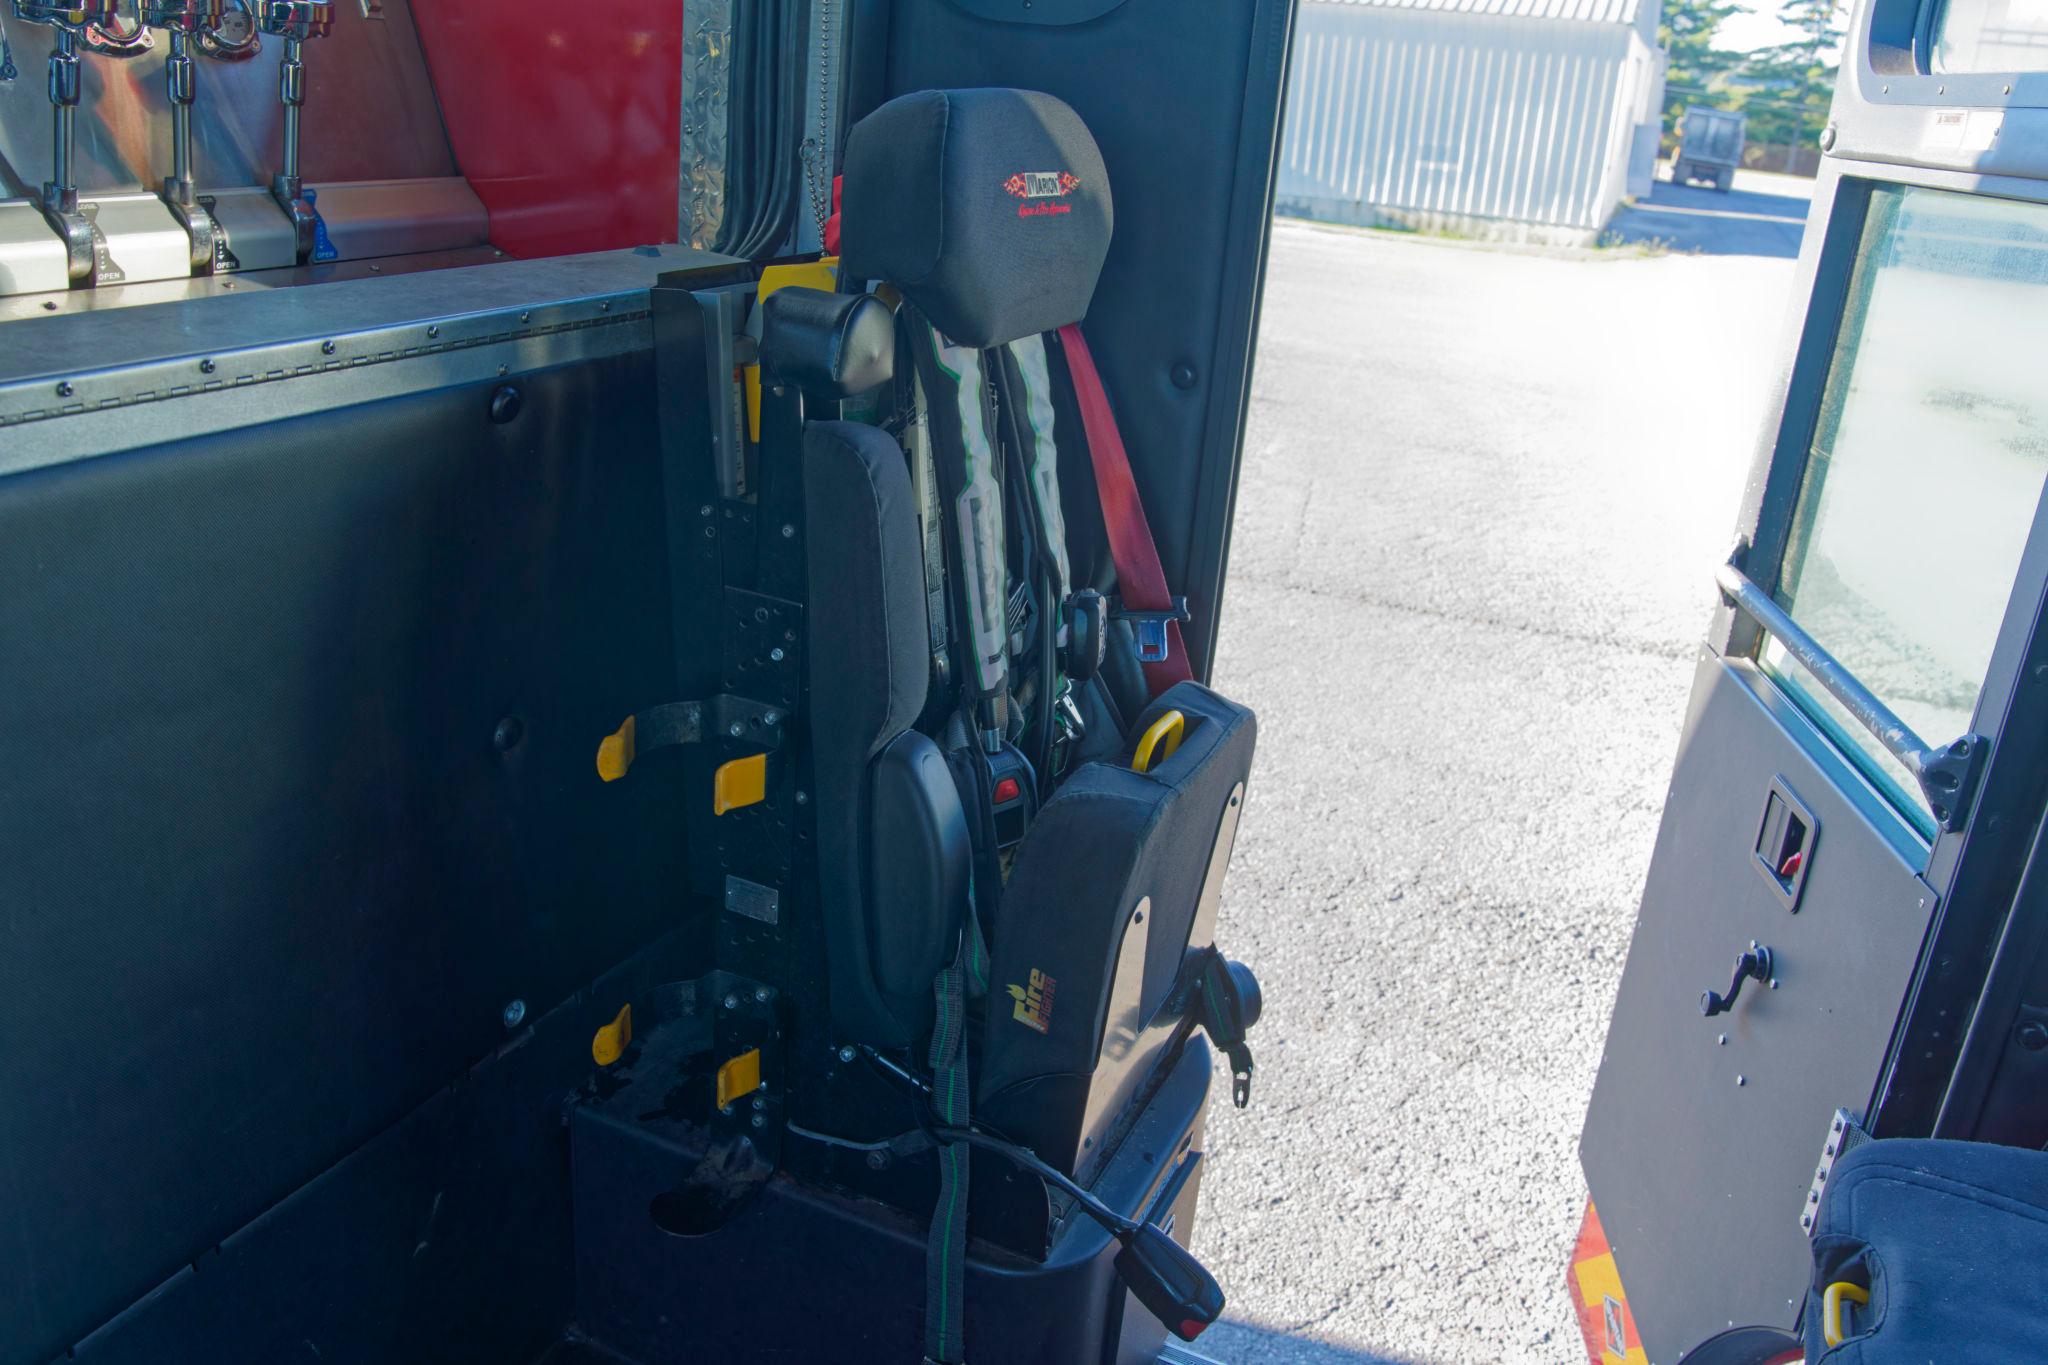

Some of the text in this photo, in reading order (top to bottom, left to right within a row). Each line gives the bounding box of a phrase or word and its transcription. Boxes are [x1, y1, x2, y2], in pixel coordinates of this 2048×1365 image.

[1026, 174, 1059, 194] MARION
[216, 262, 236, 270] OPEN
[98, 272, 120, 281] OPEN
[1008, 967, 1049, 1035] Fire
